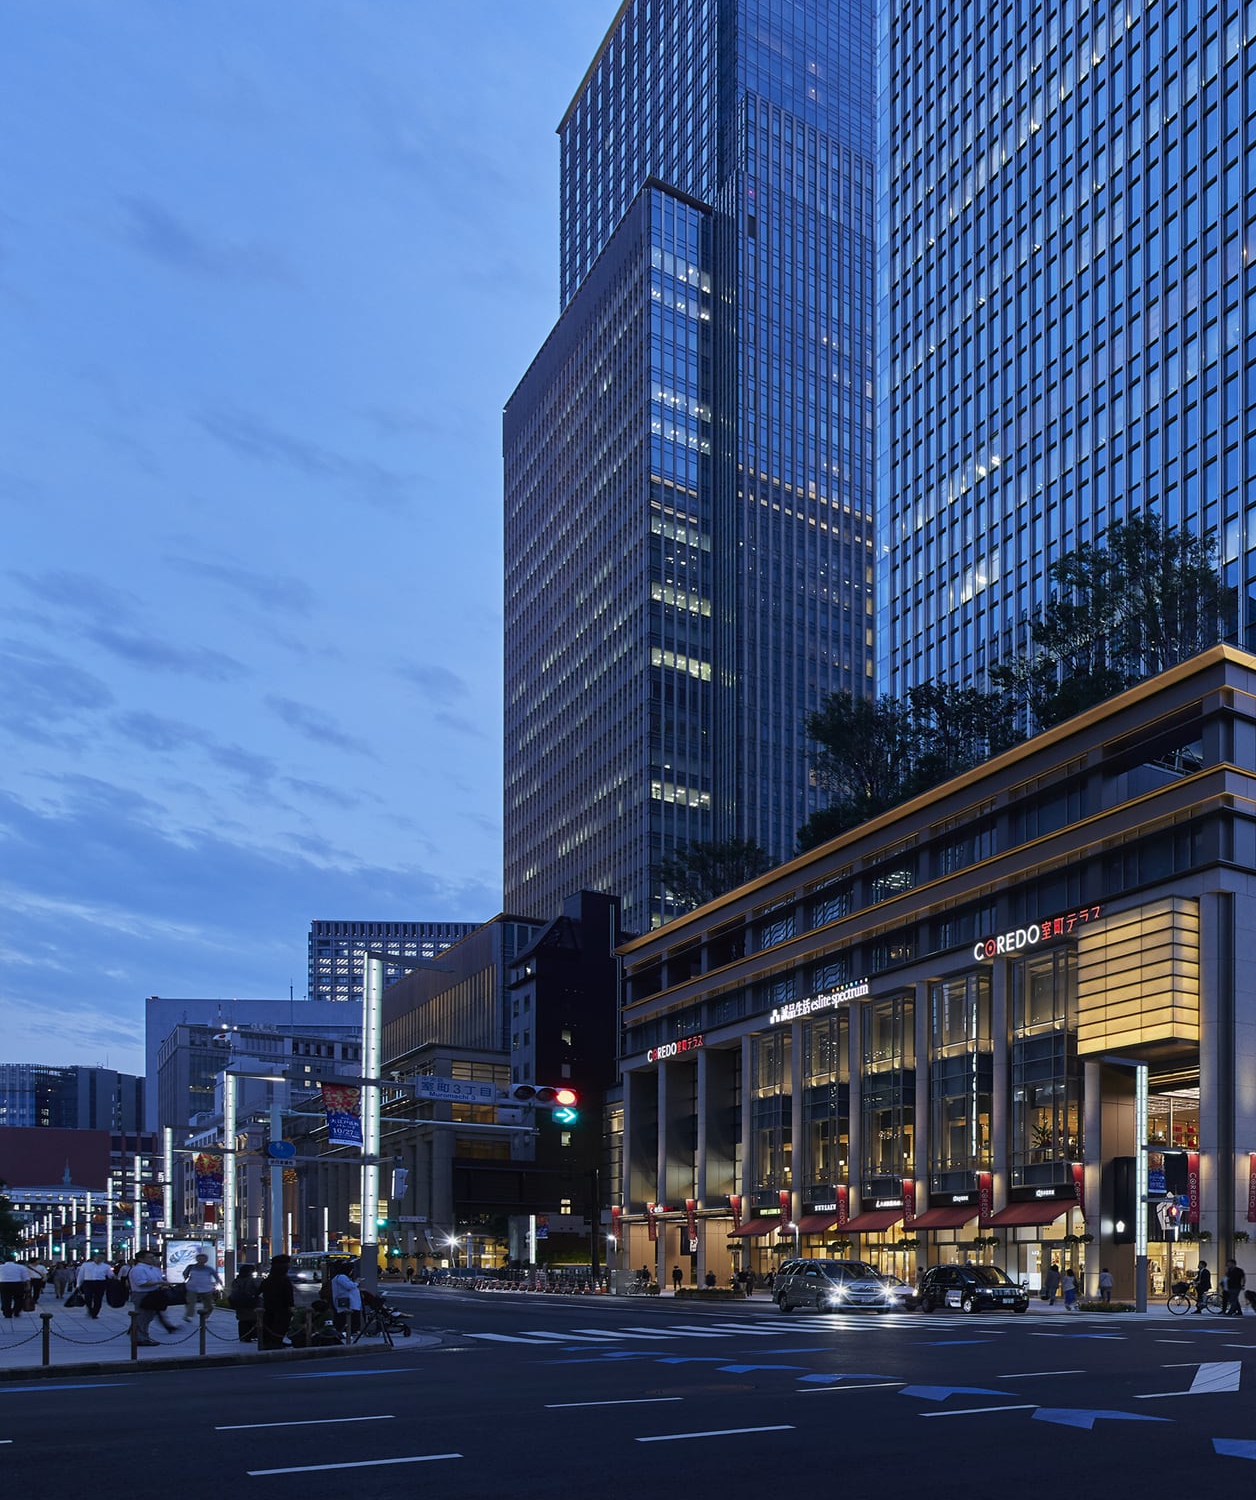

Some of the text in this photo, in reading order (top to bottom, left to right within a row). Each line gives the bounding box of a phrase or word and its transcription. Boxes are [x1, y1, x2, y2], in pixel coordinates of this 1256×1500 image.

[973, 924, 1040, 961] COREDO
[811, 994, 831, 1011] eslite
[831, 984, 869, 1009] spectrum
[647, 1042, 677, 1063] COREDO
[420, 1081, 492, 1098] 室町3丁目
[429, 1091, 469, 1101] Muromachi
[332, 1127, 354, 1136] 10/27
[1189, 1172, 1197, 1208] COREDO
[1249, 1172, 1256, 1208] COREDO
